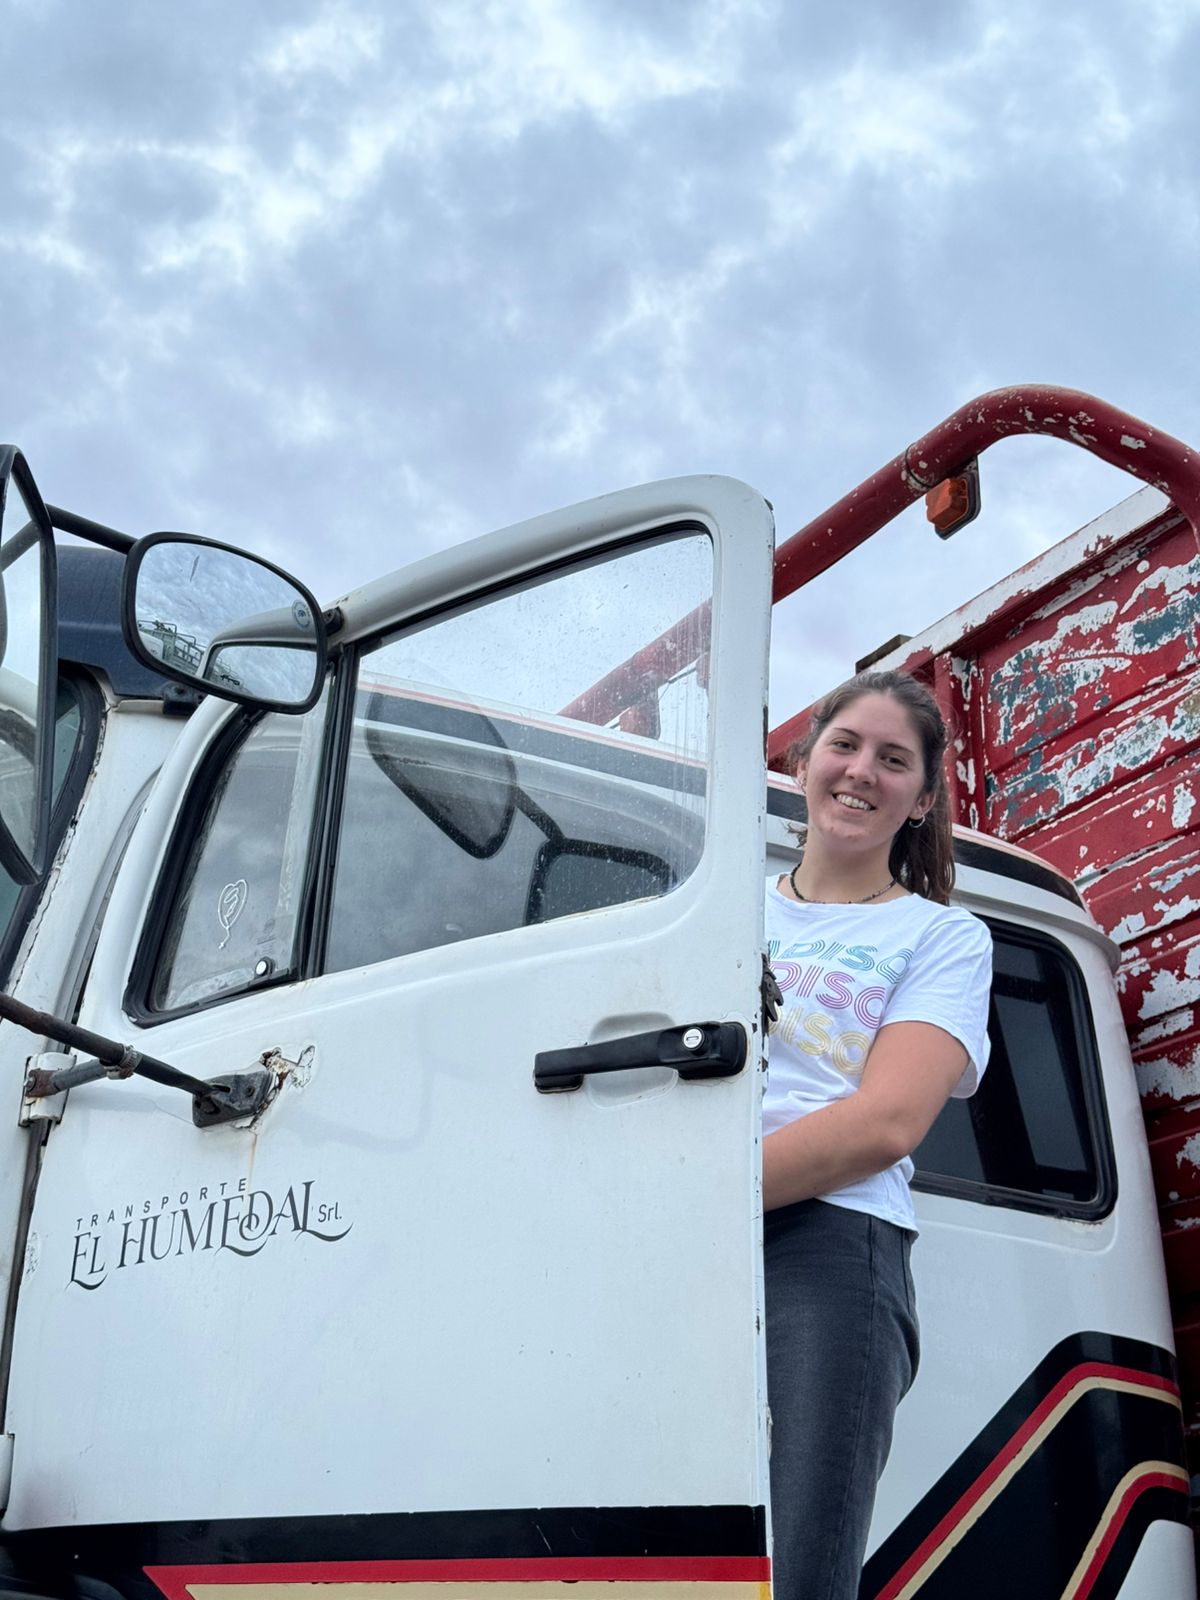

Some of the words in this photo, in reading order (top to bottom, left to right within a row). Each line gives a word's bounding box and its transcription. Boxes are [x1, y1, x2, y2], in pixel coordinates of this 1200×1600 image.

[64, 1231, 109, 1291] EL
[115, 1180, 354, 1269] HUMEDAL
[317, 1201, 343, 1223] Srl.
[75, 1177, 248, 1232] TRANSPORTE
